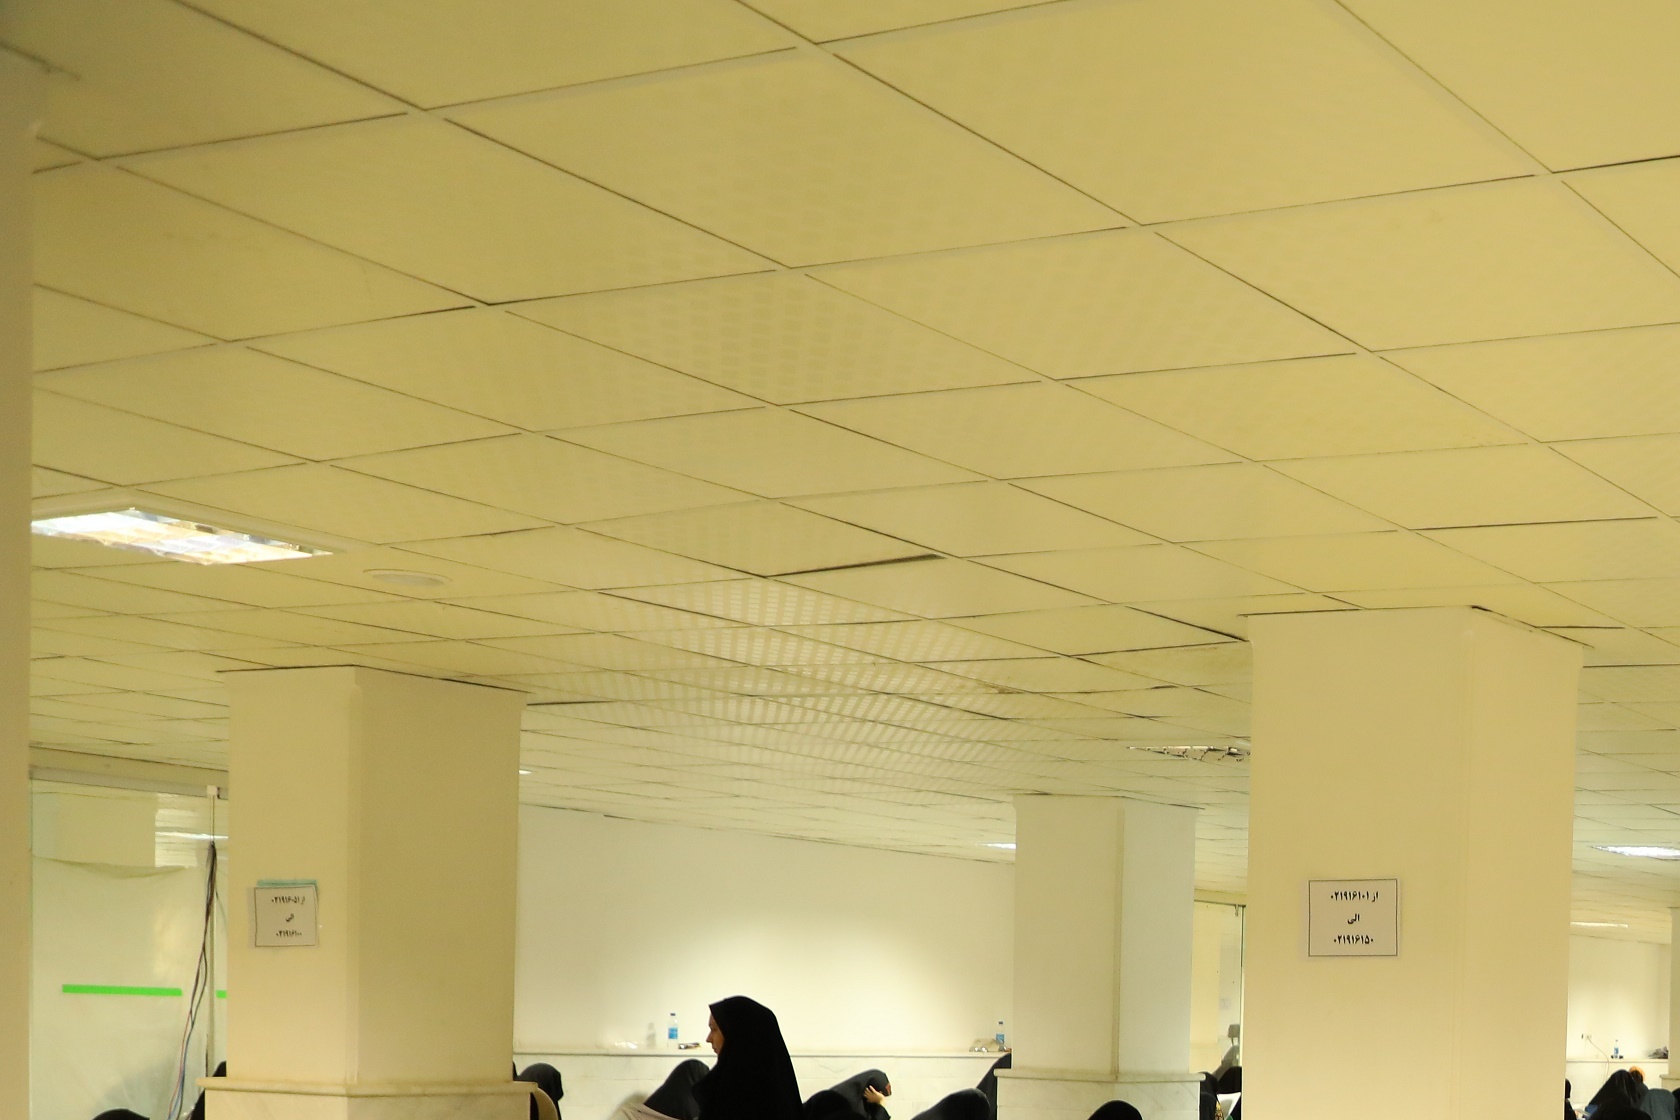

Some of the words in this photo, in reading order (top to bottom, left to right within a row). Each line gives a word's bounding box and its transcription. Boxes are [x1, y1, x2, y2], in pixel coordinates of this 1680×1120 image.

[1330, 890, 1370, 901] ۰۲۱۹۱۶۱۰۱
[1371, 890, 1379, 903] از
[1347, 913, 1360, 925] الی
[1333, 934, 1374, 945] ۰۲۱۹۱۶۱۵۰
